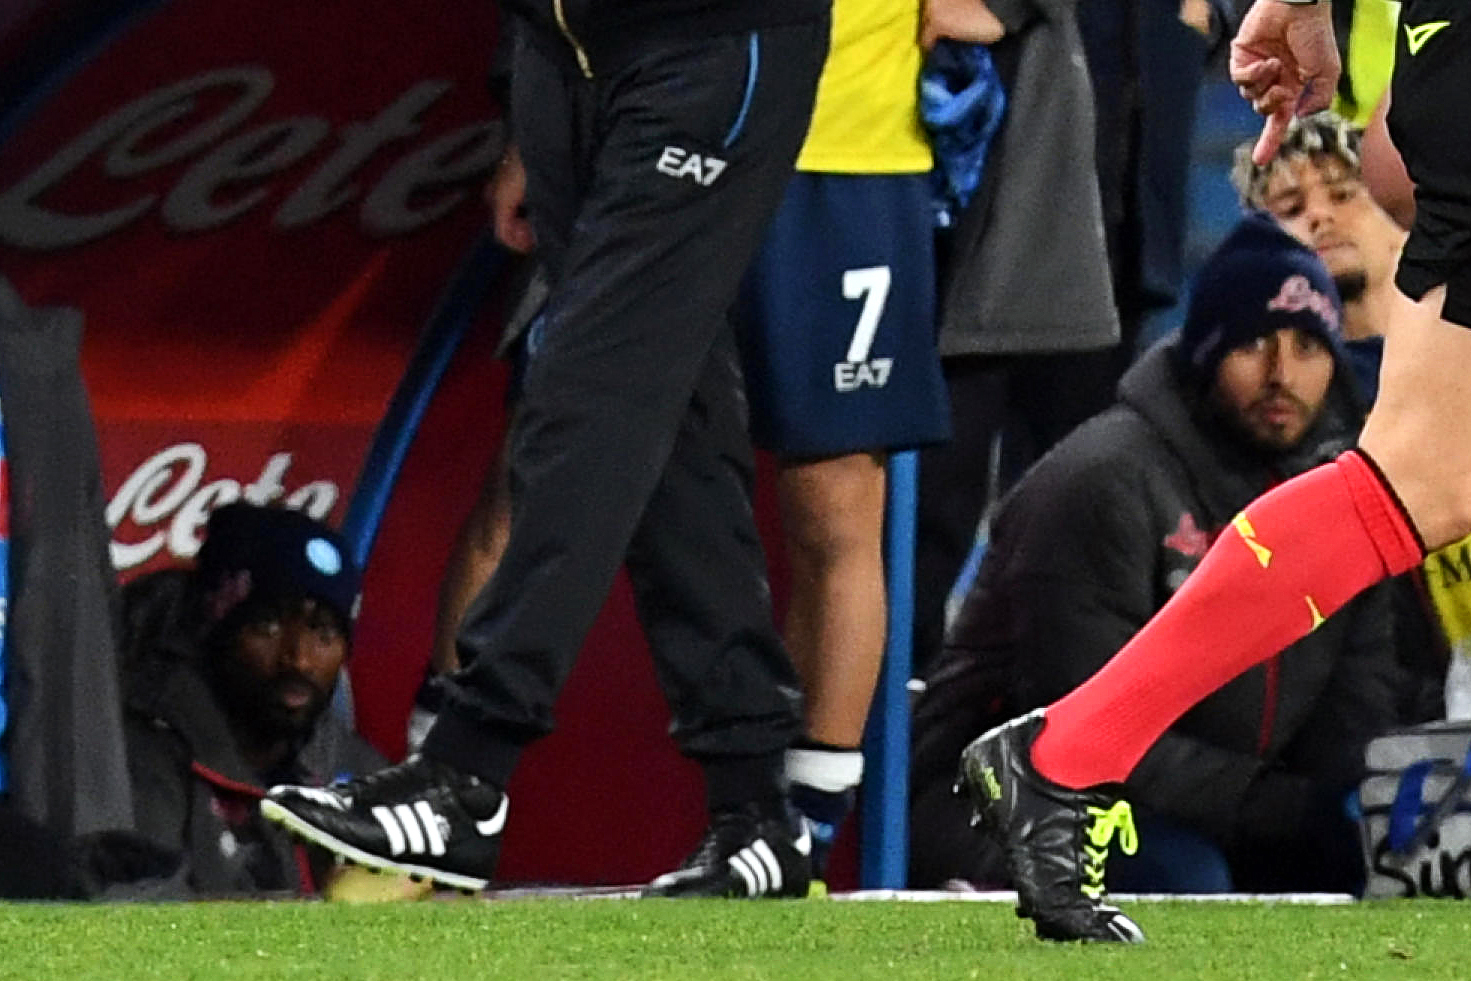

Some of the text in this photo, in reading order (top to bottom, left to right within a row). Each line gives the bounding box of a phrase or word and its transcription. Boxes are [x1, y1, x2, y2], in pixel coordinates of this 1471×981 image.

[0, 63, 506, 251] Lete
[656, 146, 727, 187] EA7
[842, 265, 892, 362] 7
[834, 358, 894, 392] EA7
